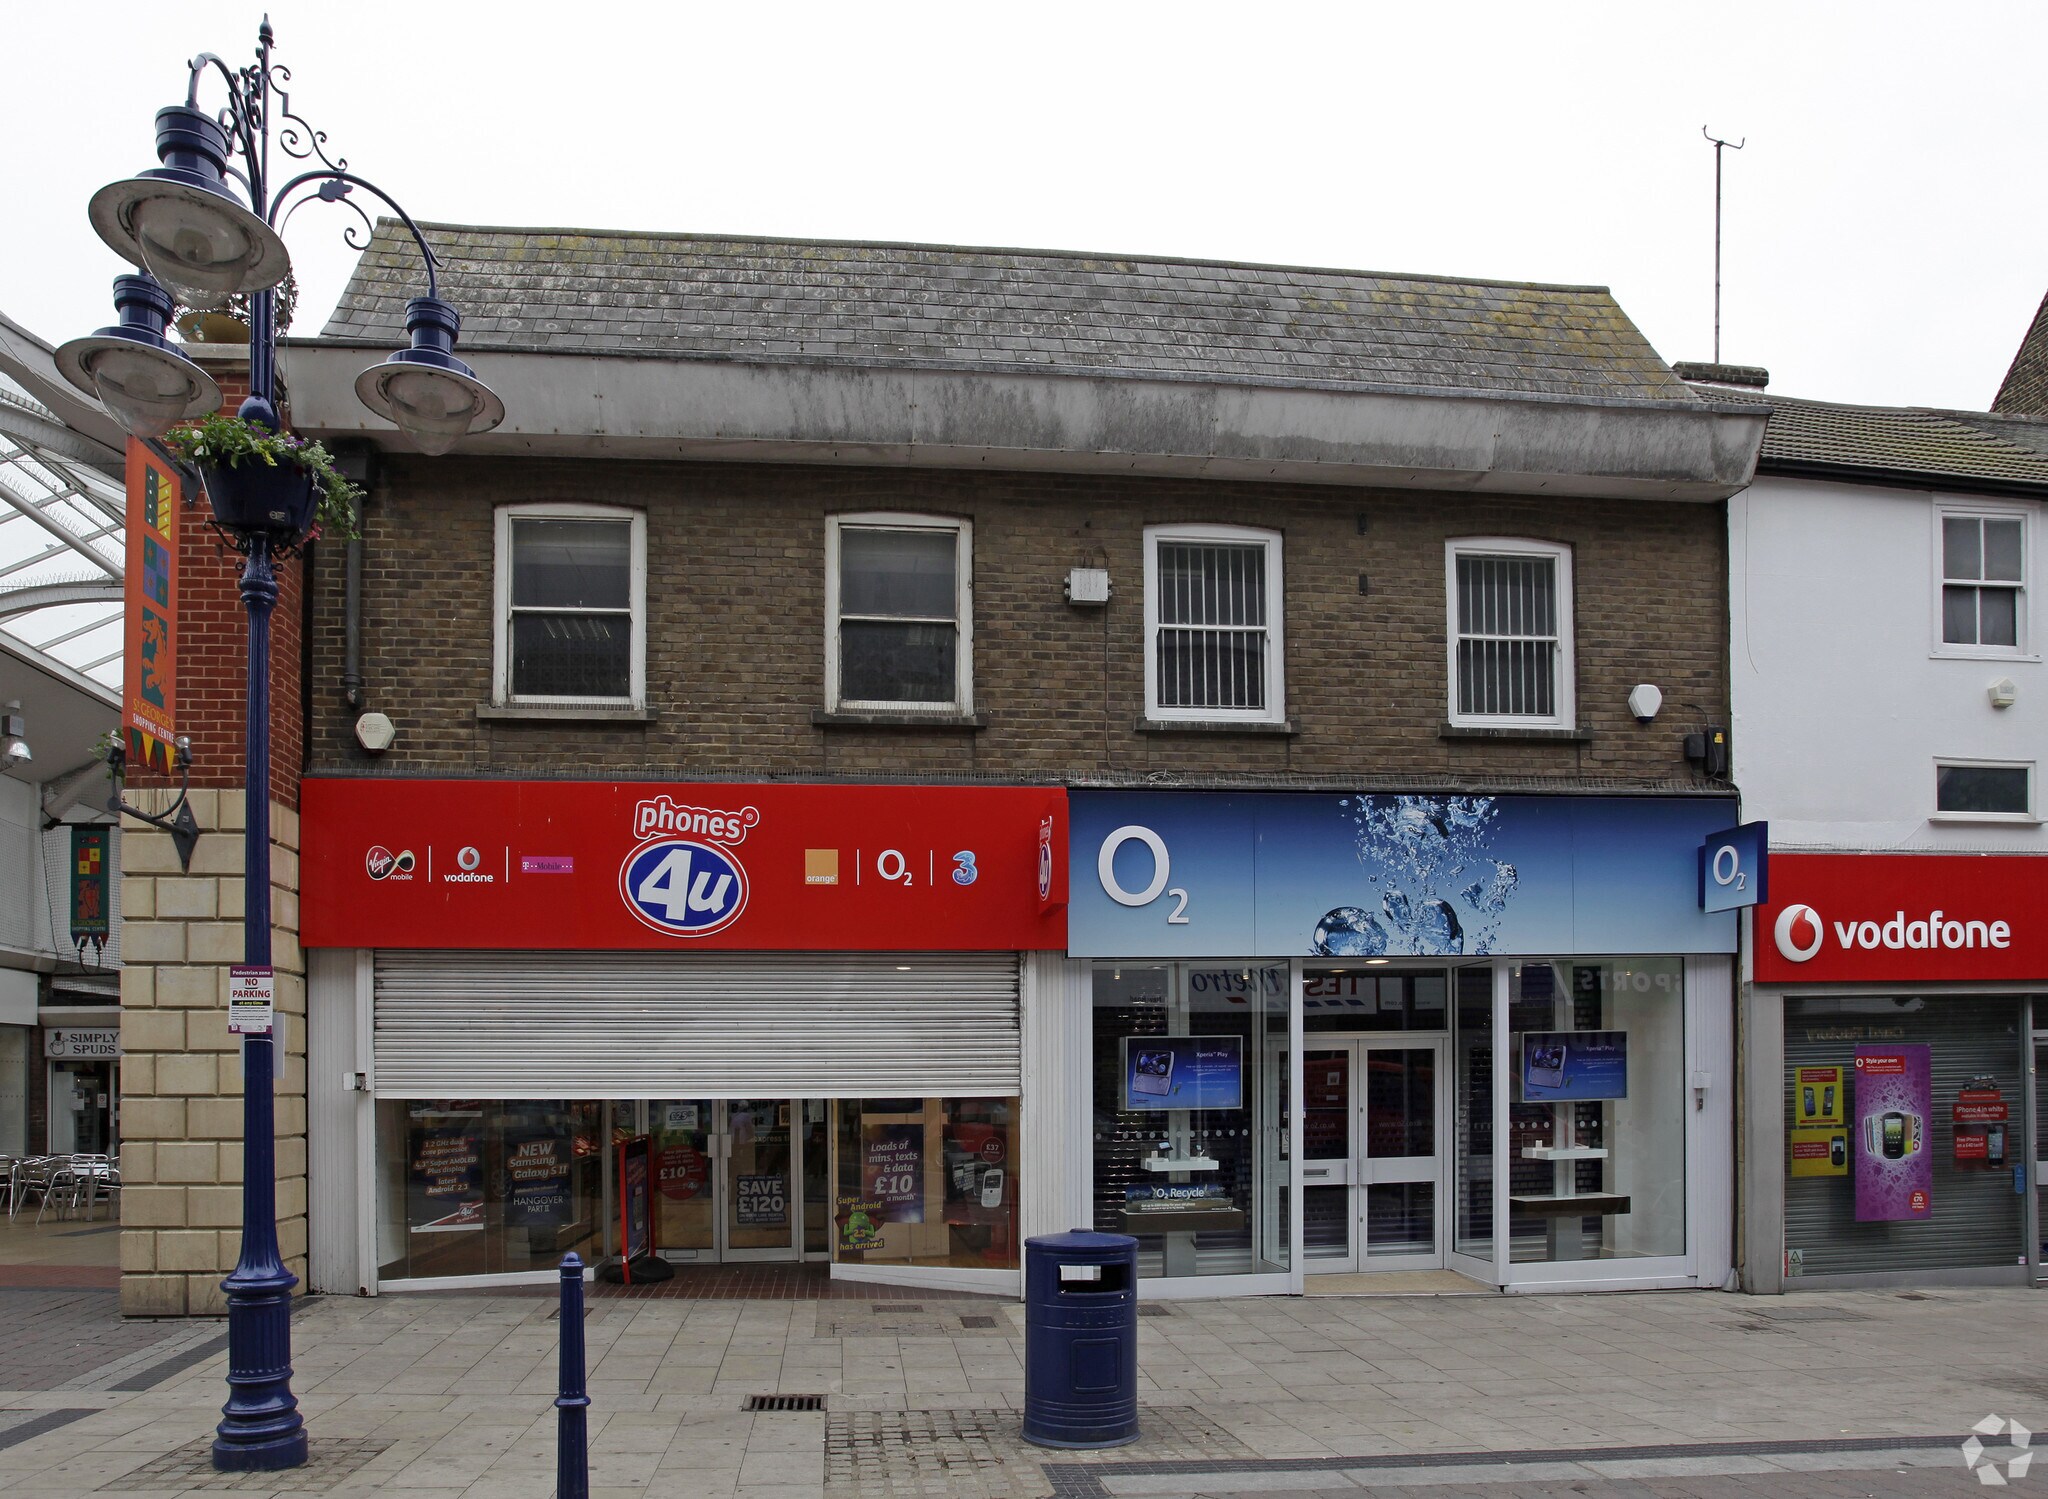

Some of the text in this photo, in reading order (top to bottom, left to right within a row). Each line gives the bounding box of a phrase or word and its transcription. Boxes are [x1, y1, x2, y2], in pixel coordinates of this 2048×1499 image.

[133, 713, 175, 743] SHOPPING CENTRE
[640, 802, 741, 839] phones
[368, 852, 392, 874] Virgin
[952, 850, 978, 886] 3
[444, 872, 494, 883] vodafone
[806, 875, 836, 884] orange
[638, 848, 733, 921] 4u
[1833, 910, 2011, 950] vodafone
[245, 978, 258, 986] NO
[232, 990, 271, 998] PARKING
[70, 1032, 120, 1043] SIMPLY
[73, 1044, 116, 1054] SPUDS
[519, 1142, 553, 1157] NEW
[871, 1140, 909, 1152] Loads of
[510, 1156, 556, 1168] Samsung
[869, 1151, 918, 1163] mins, texts
[430, 1160, 448, 1168] Super
[884, 1163, 914, 1173] & data
[514, 1165, 567, 1179] Galaxy S II
[659, 1166, 686, 1180] £10
[738, 1180, 783, 1196] SAVE
[874, 1174, 913, 1195] £10
[1170, 1187, 1204, 1200] Recycle
[513, 1195, 564, 1206] HANGOVER
[738, 1195, 785, 1213] £120
[838, 1197, 860, 1205] Super
[527, 1205, 543, 1213] PART
[853, 1229, 866, 1238] 2.3
[855, 1240, 884, 1249] arrived
